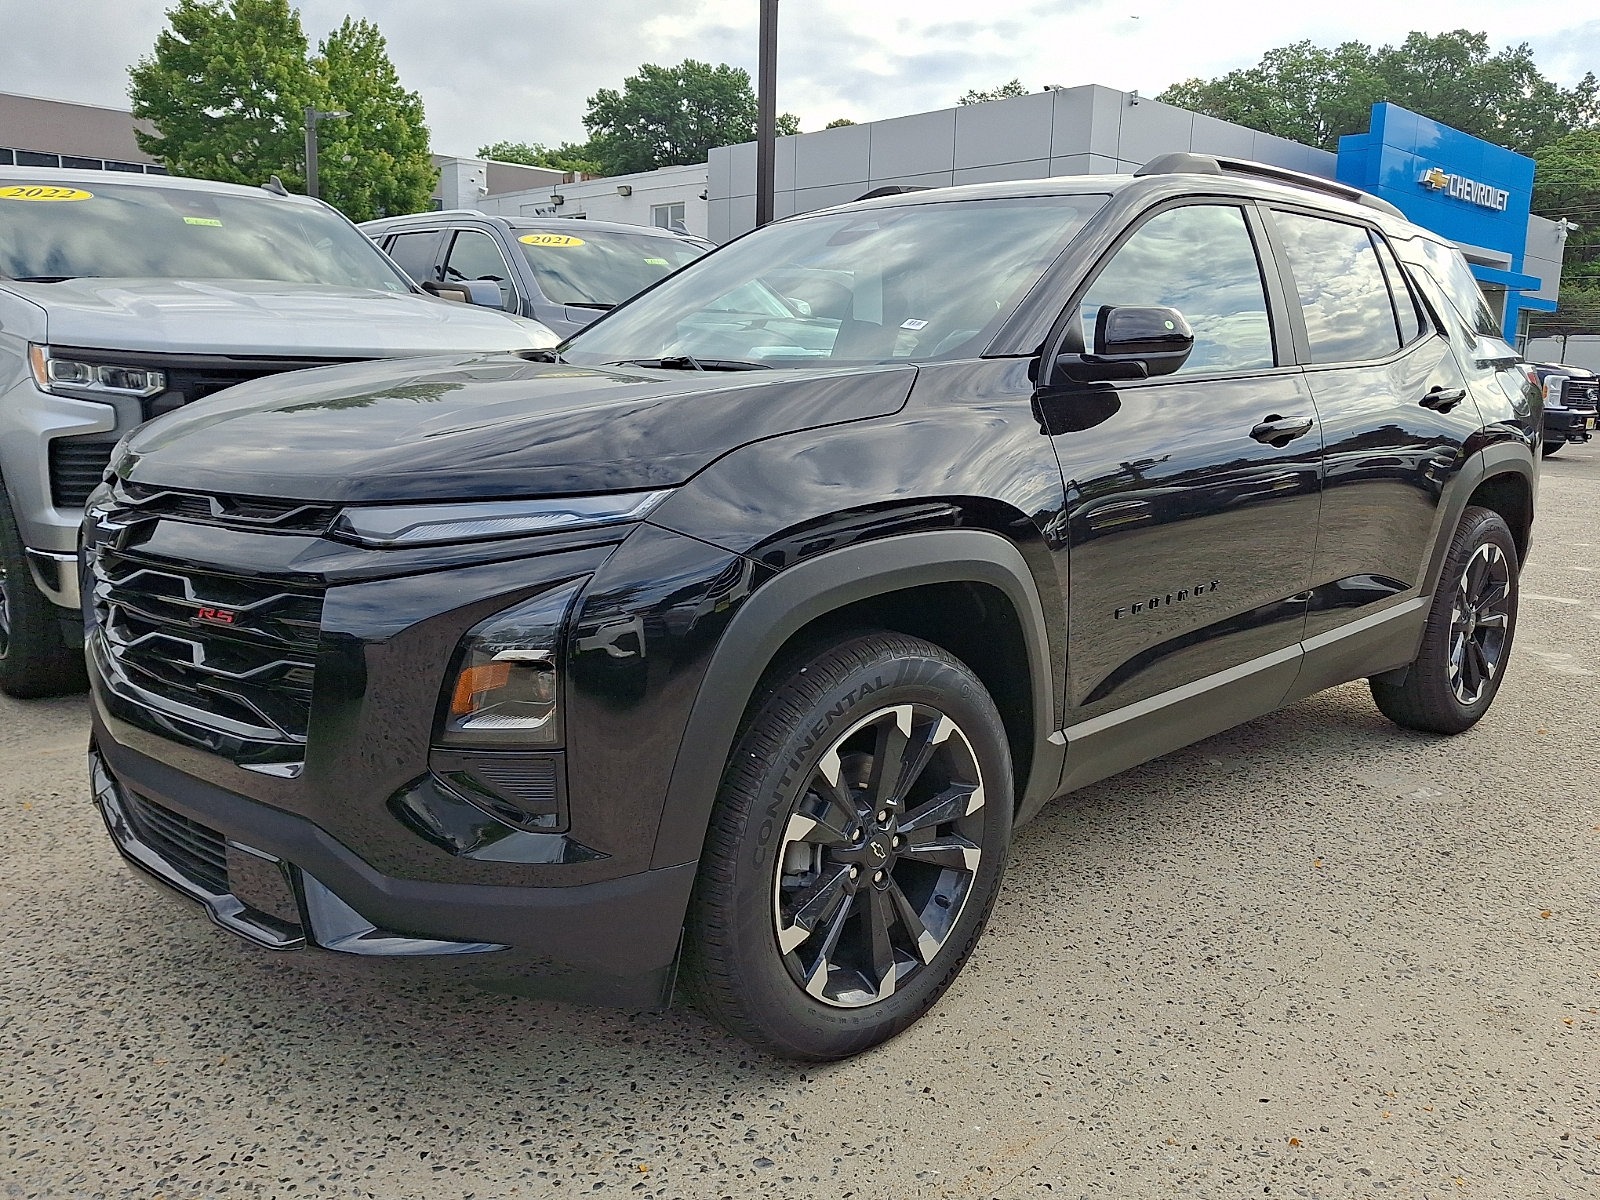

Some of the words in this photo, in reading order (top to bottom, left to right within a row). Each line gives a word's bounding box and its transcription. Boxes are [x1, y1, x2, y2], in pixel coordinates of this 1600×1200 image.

[8, 186, 77, 199] 2022
[1449, 173, 1509, 211] CHEVROLET
[531, 236, 571, 245] 2021
[197, 606, 235, 623] RS
[752, 675, 890, 871] CONTINENTAL
